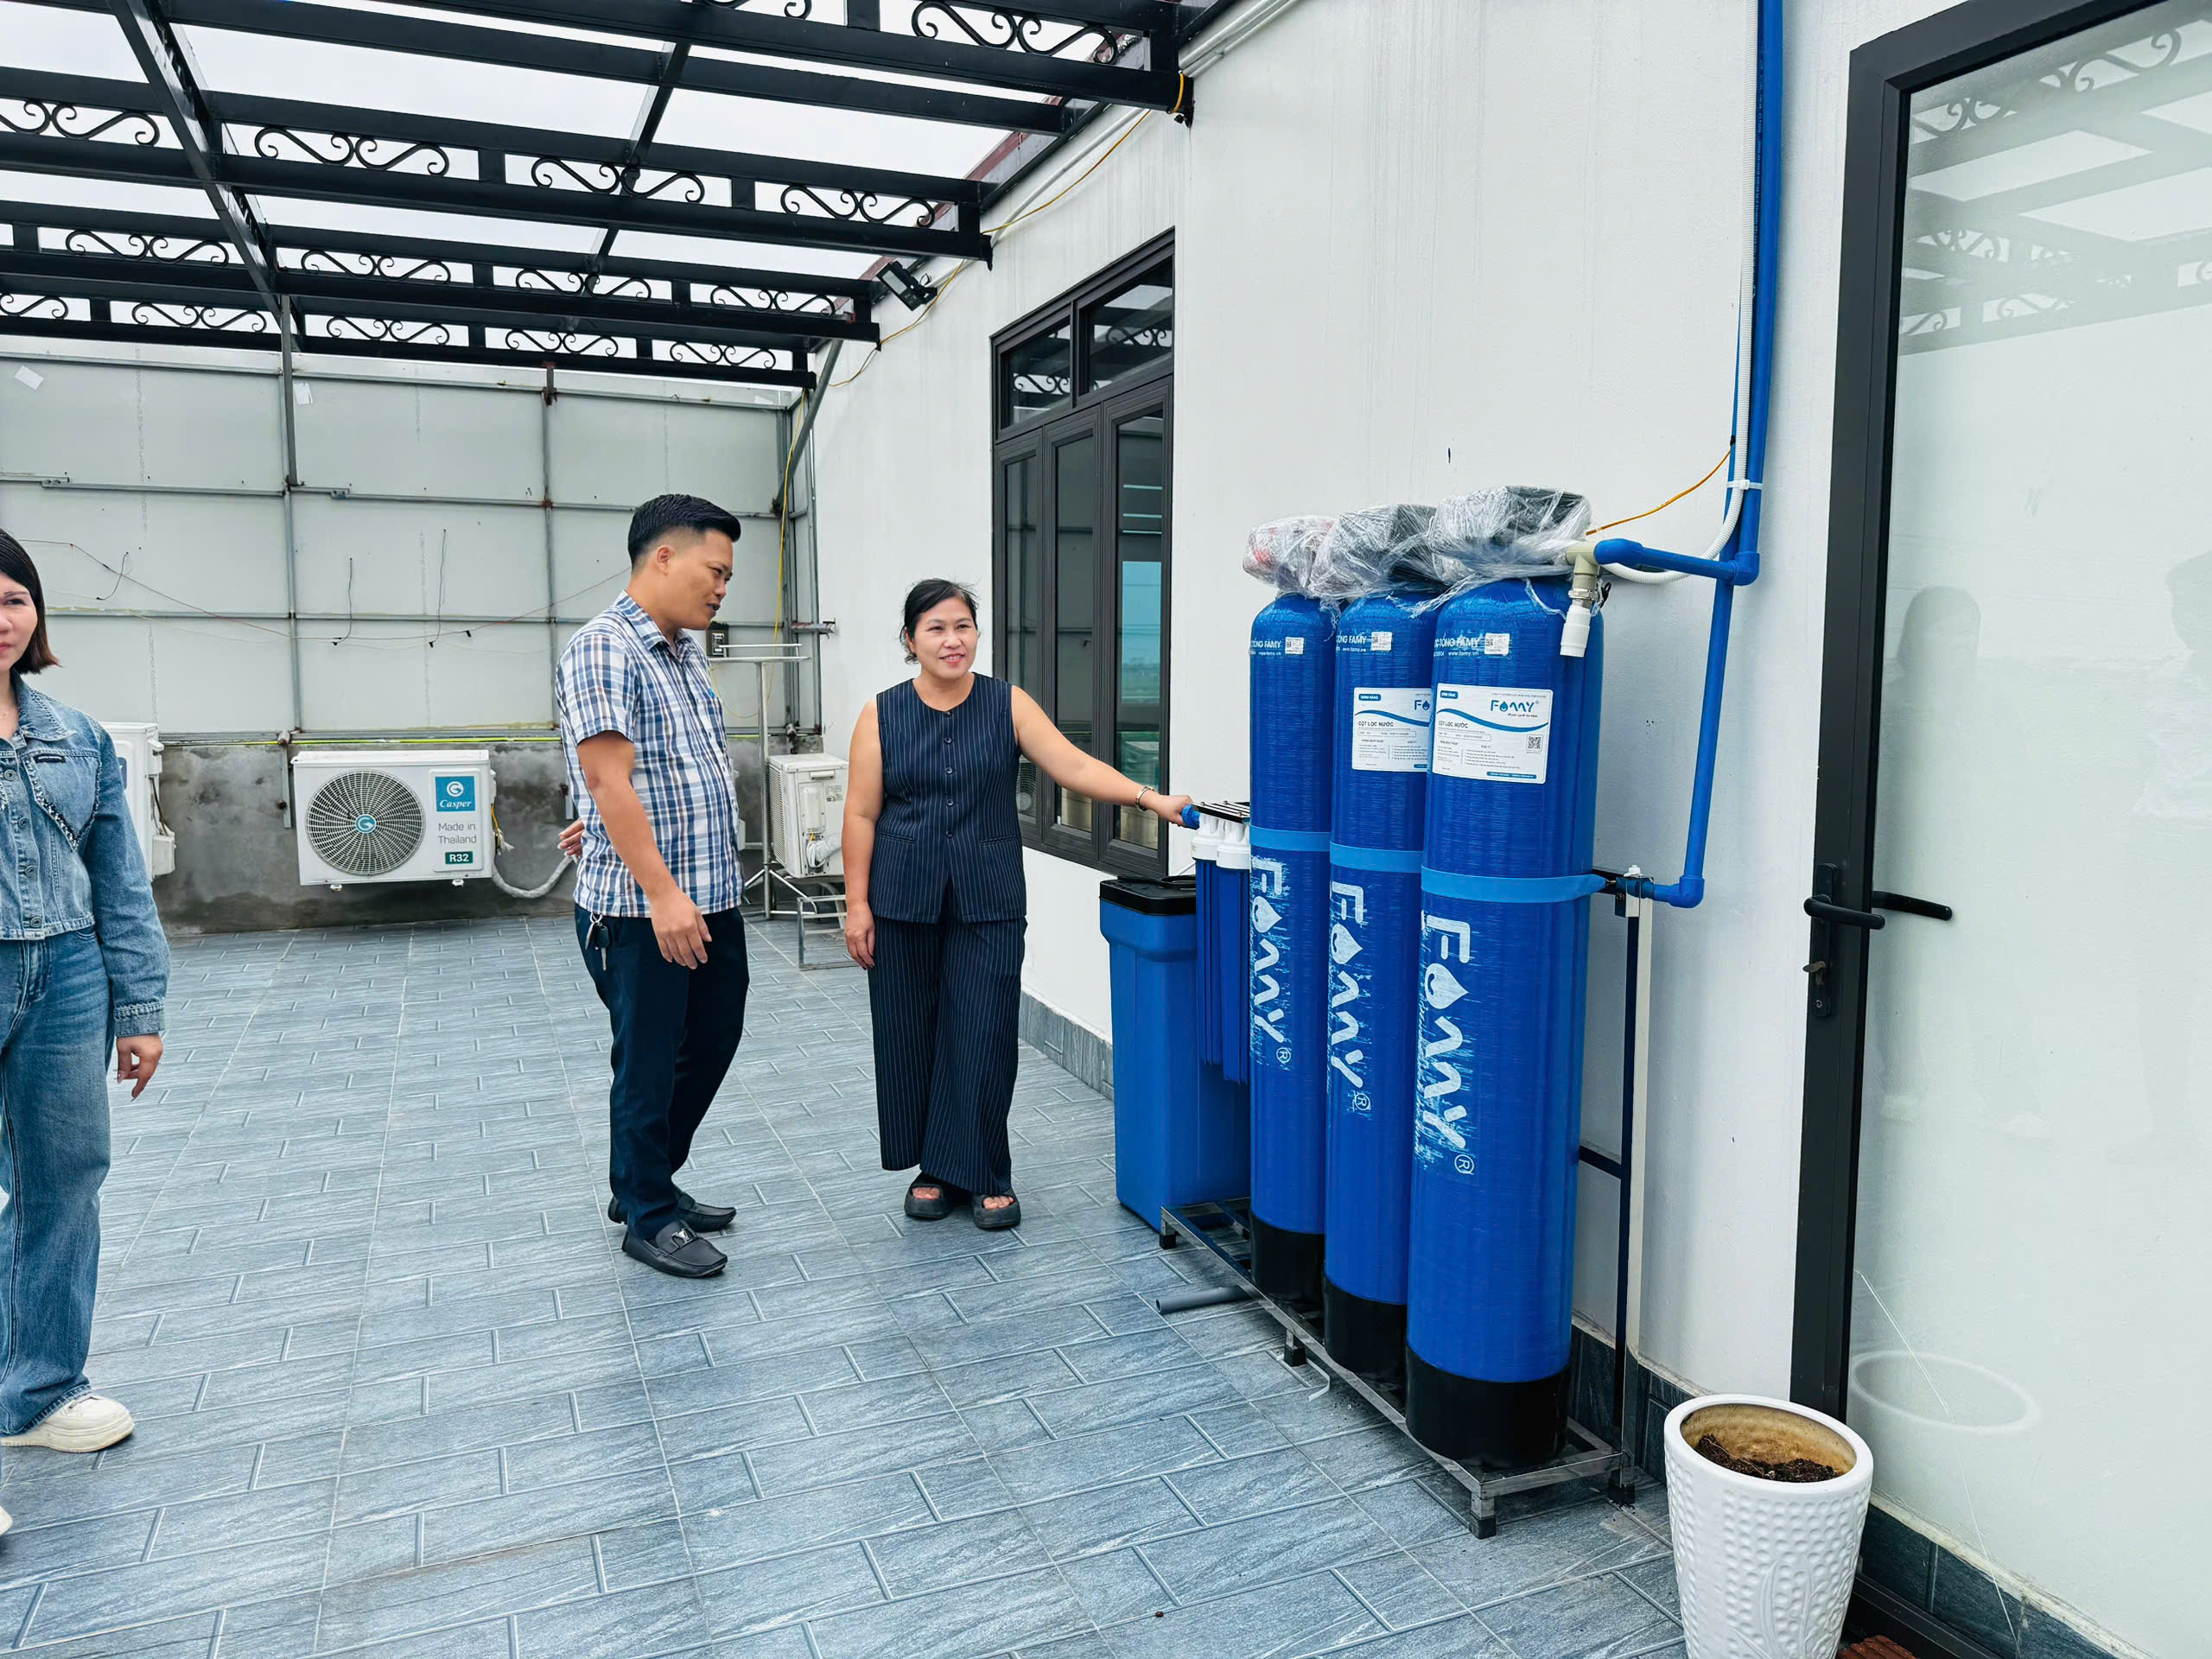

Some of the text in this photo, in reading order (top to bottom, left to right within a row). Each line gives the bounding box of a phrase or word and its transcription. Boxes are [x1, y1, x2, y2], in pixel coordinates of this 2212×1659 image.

[1264, 640, 1281, 649] FAMY
[1349, 635, 1367, 645] FAMY
[1456, 636, 1481, 648] FAMY
[1491, 700, 1535, 713] FAMY
[440, 799, 472, 809] Casper
[438, 823, 464, 831] Made
[449, 854, 469, 862] R32
